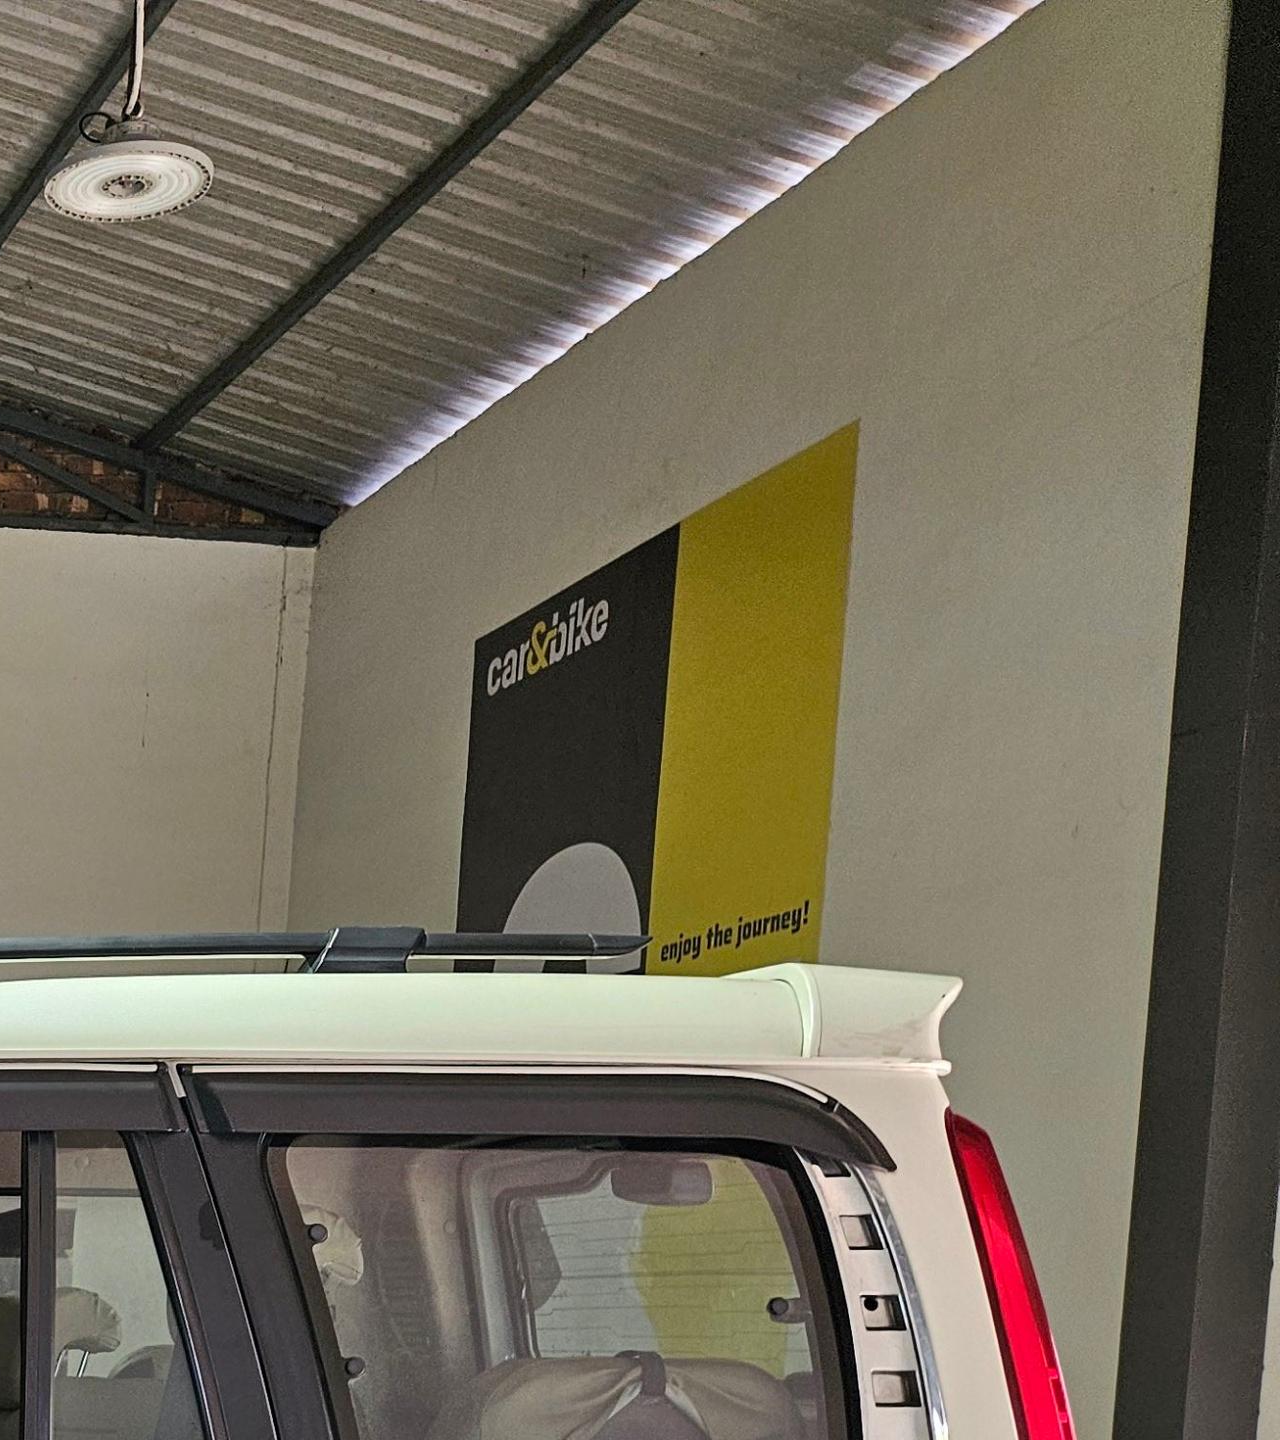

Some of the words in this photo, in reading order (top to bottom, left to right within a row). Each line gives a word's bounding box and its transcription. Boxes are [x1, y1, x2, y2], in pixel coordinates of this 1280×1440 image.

[486, 597, 609, 697] car&bike
[660, 932, 702, 963] enjoy
[706, 922, 731, 950] the
[734, 900, 810, 947] journey!
